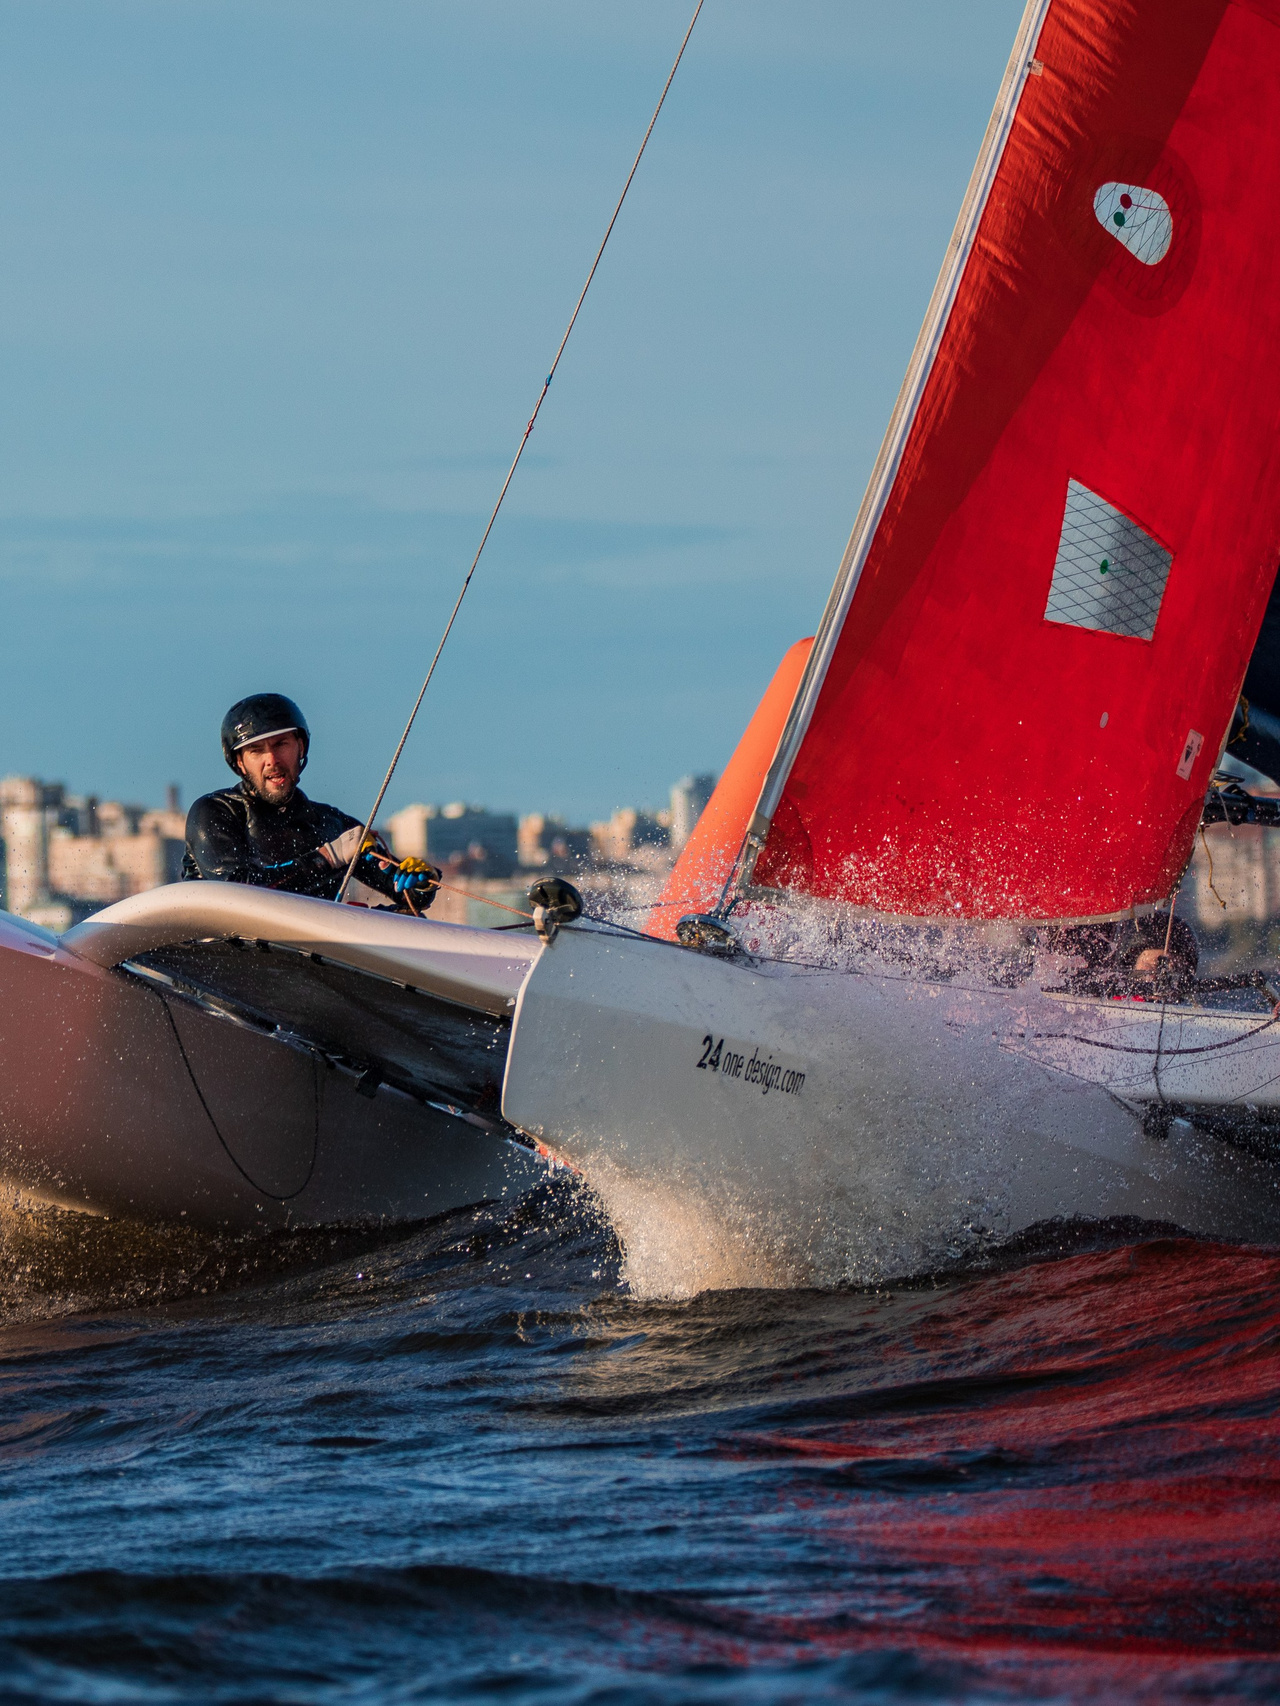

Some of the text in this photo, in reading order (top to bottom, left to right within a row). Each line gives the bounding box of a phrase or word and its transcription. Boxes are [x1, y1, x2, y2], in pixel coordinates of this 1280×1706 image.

[696, 1034, 806, 1096] 24 one design.com
